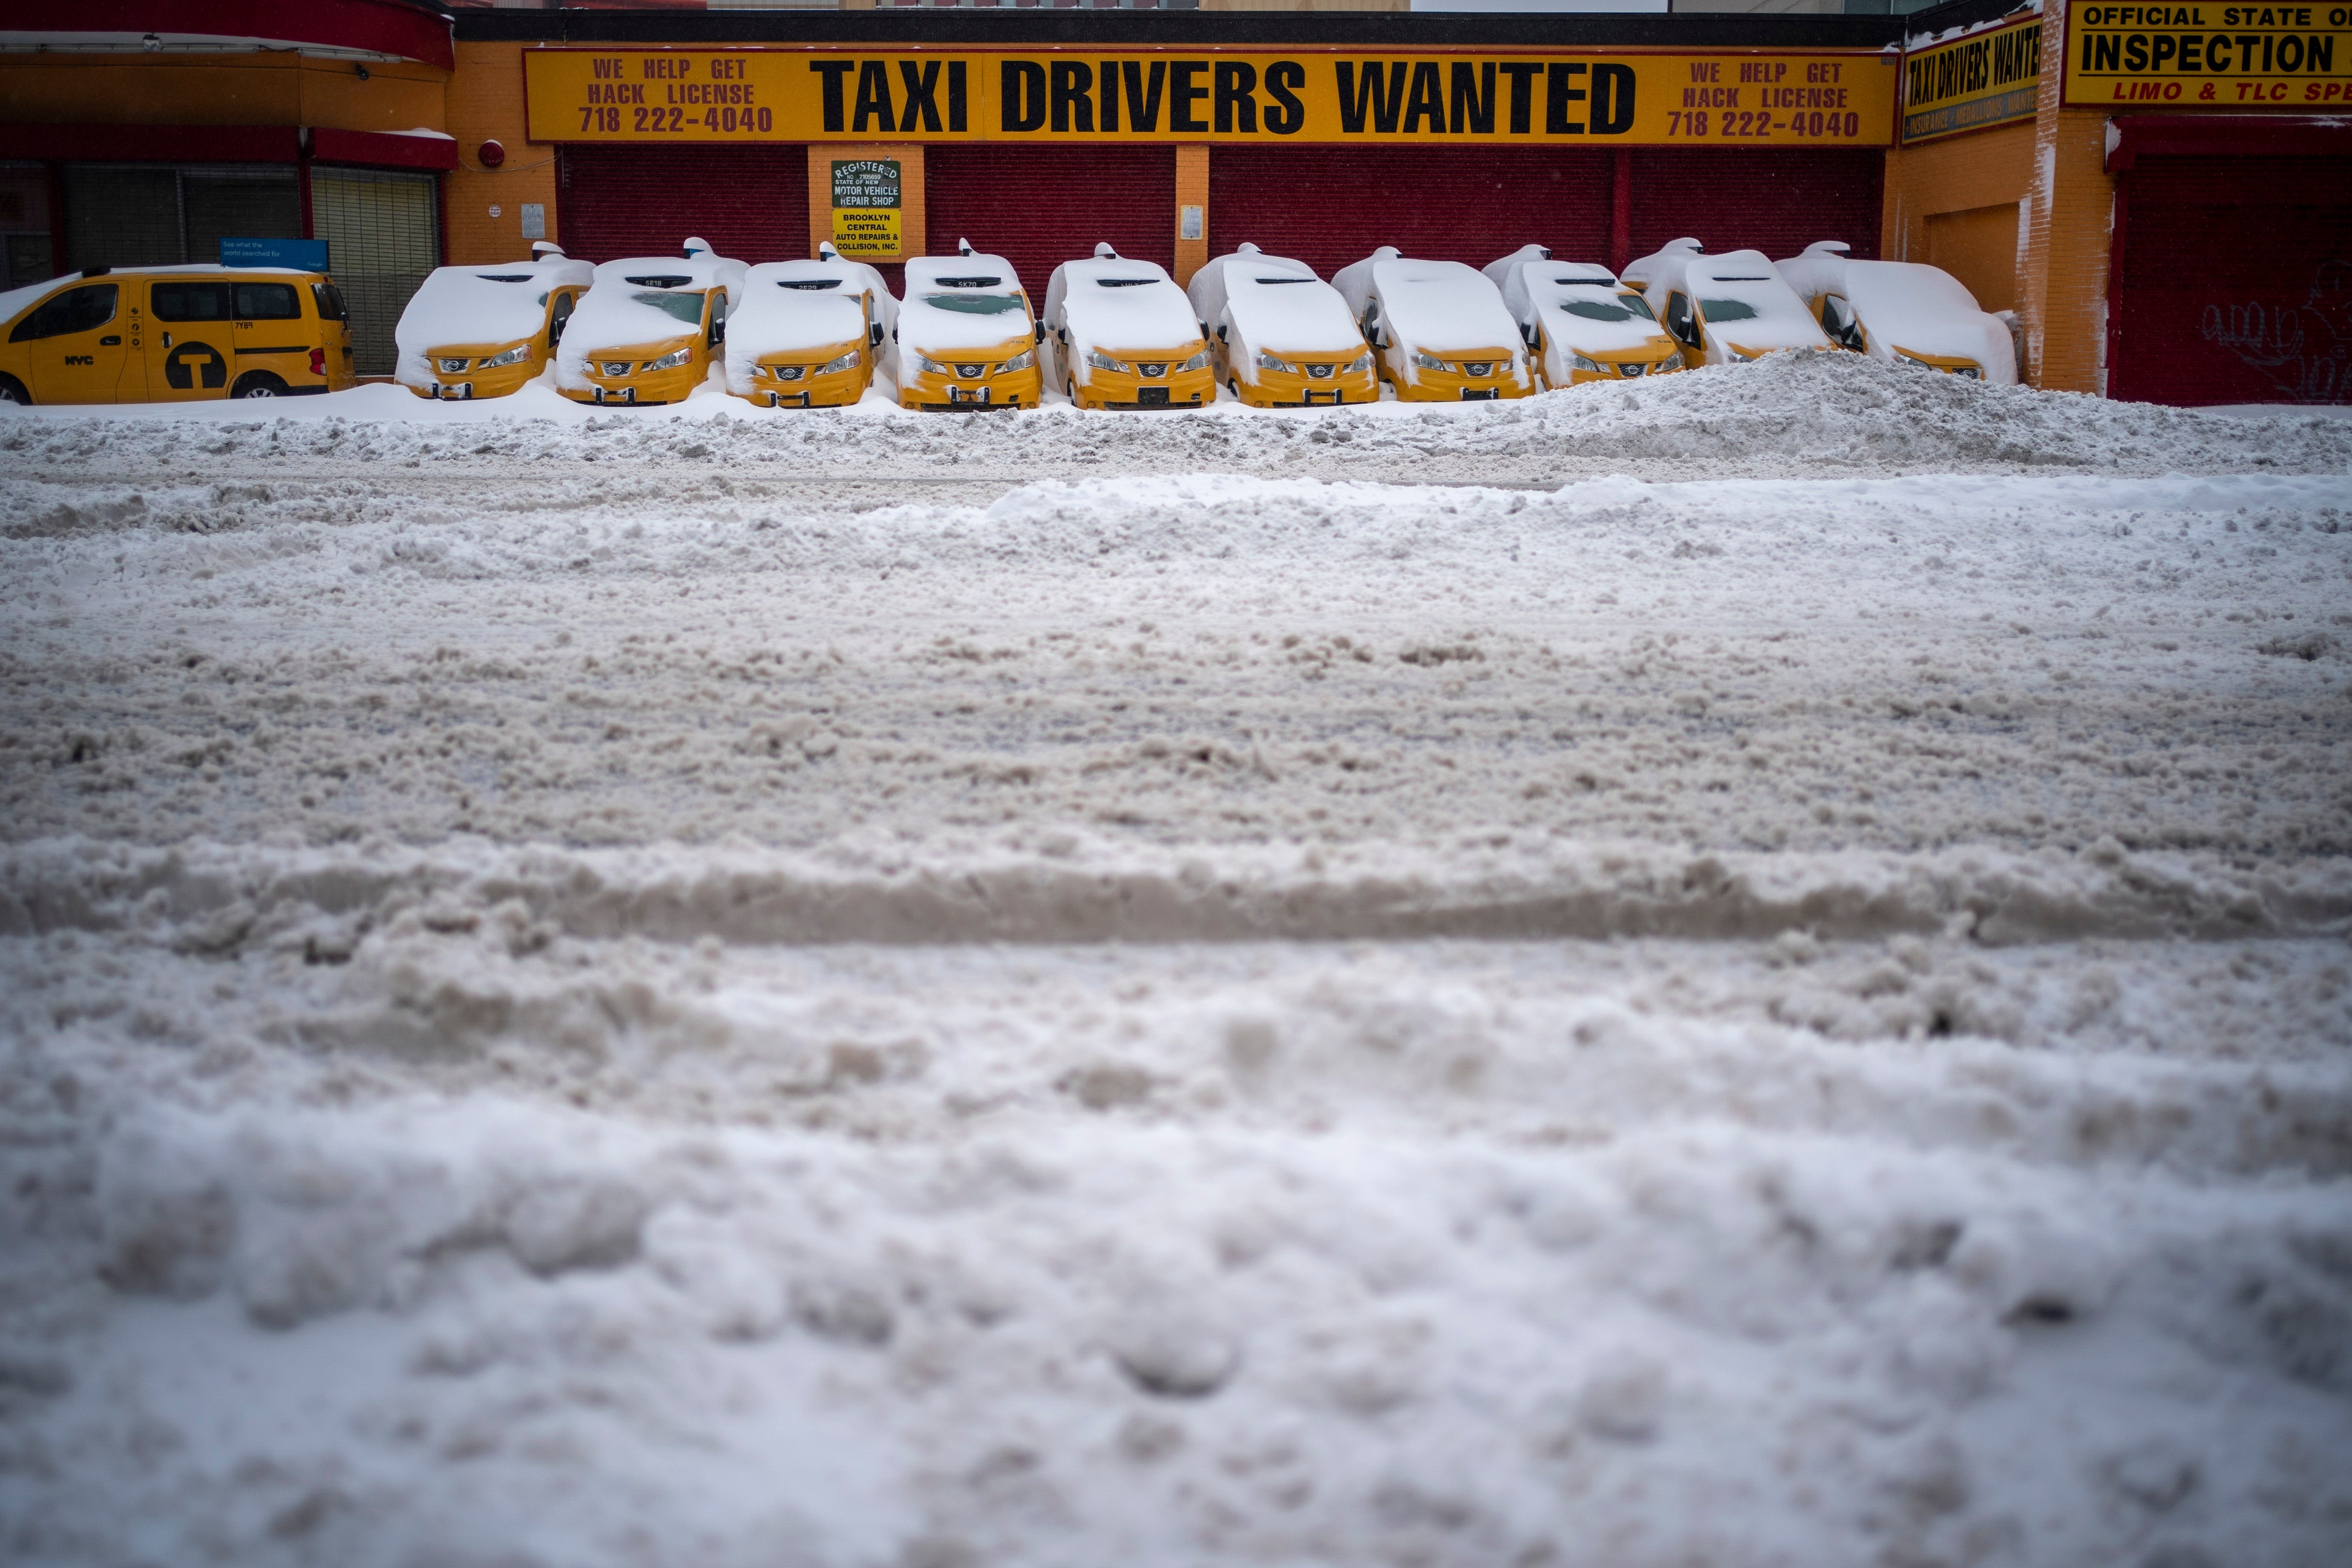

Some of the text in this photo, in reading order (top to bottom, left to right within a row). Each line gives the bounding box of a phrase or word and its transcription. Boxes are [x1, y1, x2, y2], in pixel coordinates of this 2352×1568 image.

[2083, 7, 2352, 26] OFFICIAL STATE O
[2082, 34, 2334, 73] INSPECTION
[593, 59, 746, 79] WE HELP GET
[1690, 63, 1842, 83] WE HELP GET
[1910, 25, 2041, 107] TAXI DRIVERS WANTE
[588, 84, 754, 104] HACK LICENSE
[809, 60, 1636, 135] TAXI DRIVERS WANTED
[1683, 88, 1847, 109] HACK LICENSE
[2113, 83, 2182, 101] LIMO
[2199, 83, 2216, 101] &
[2236, 83, 2288, 101] TLC
[579, 107, 772, 132] 718 222-4040
[1667, 111, 1859, 137] 718 222-4040
[1910, 110, 1948, 135] INSURANCE
[1956, 99, 2002, 125] MEDALLIONS
[835, 186, 898, 195] MOTOR VEHICLE
[840, 197, 894, 205] REPAIR SHOP
[65, 355, 94, 365] NYC
